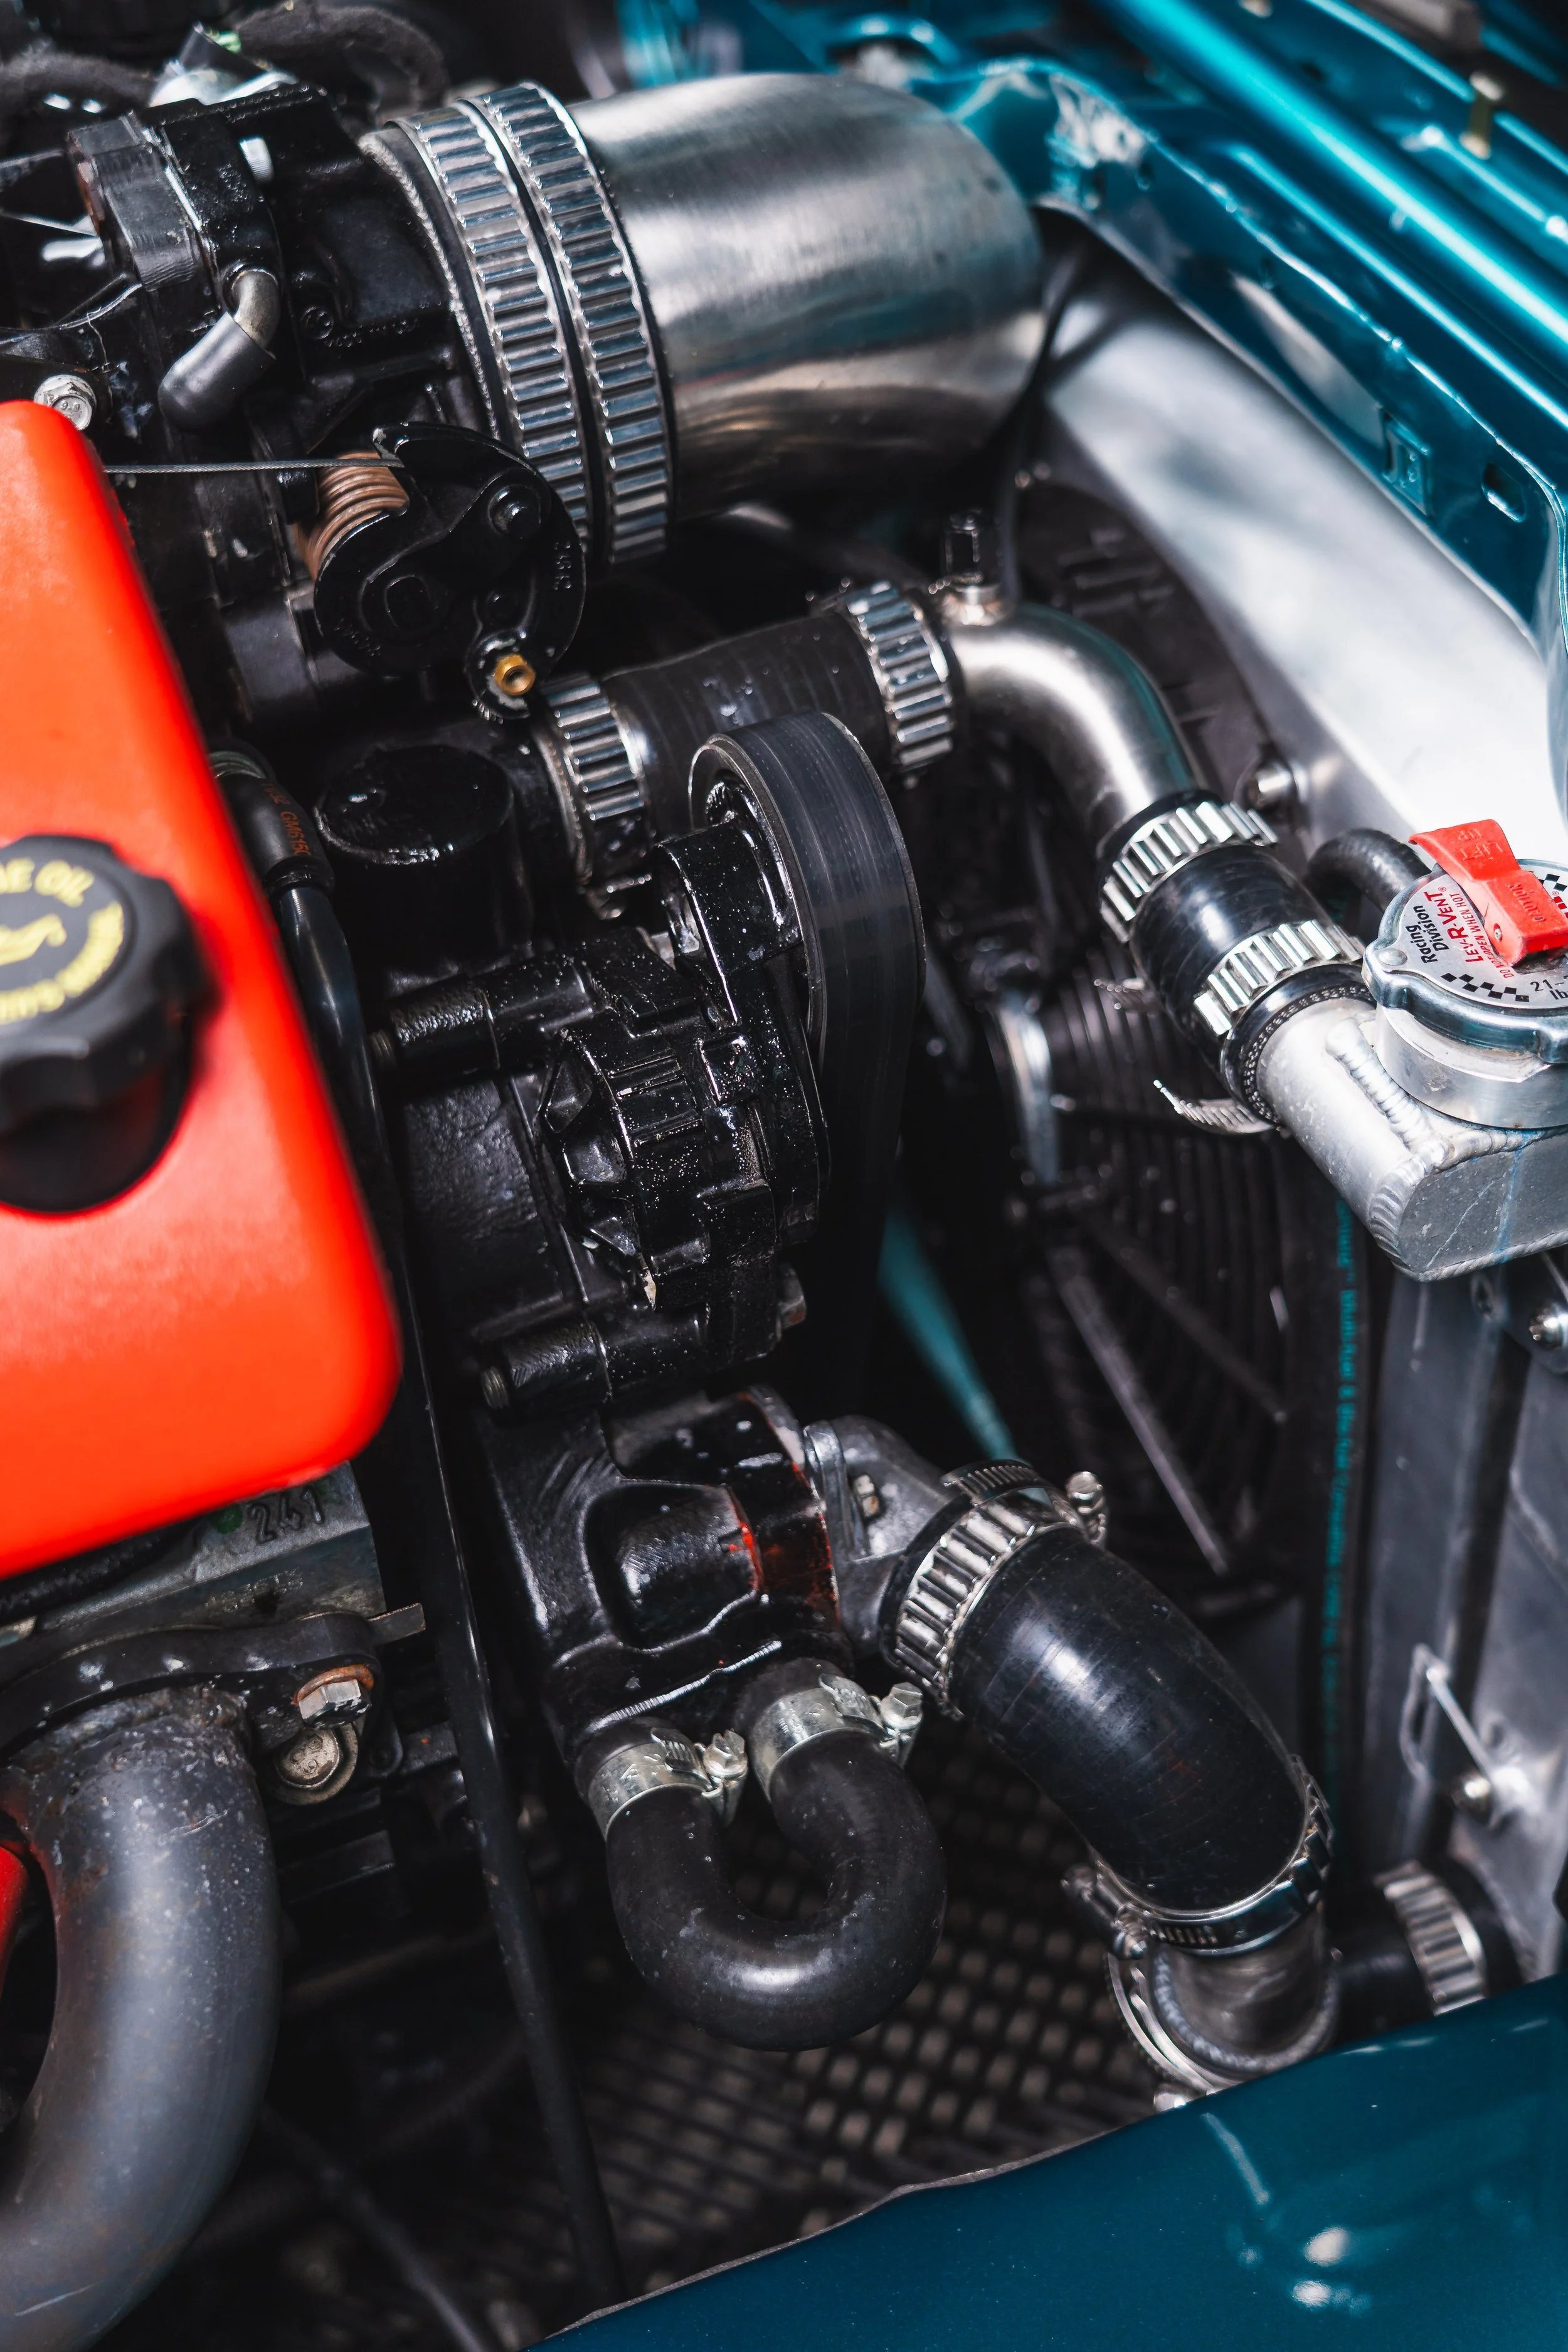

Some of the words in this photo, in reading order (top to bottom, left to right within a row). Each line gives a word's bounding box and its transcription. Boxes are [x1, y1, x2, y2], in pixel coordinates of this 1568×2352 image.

[1449, 893, 1467, 908] HOT
[1412, 905, 1449, 951] Division
[1459, 909, 1481, 933] WHEN
[1405, 925, 1438, 964] Racing
[1473, 935, 1493, 956] OPEN
[1487, 956, 1506, 968] NOT
[1500, 969, 1515, 978] DO
[1549, 989, 1568, 1000] lb
[248, 1486, 325, 1545] 241
